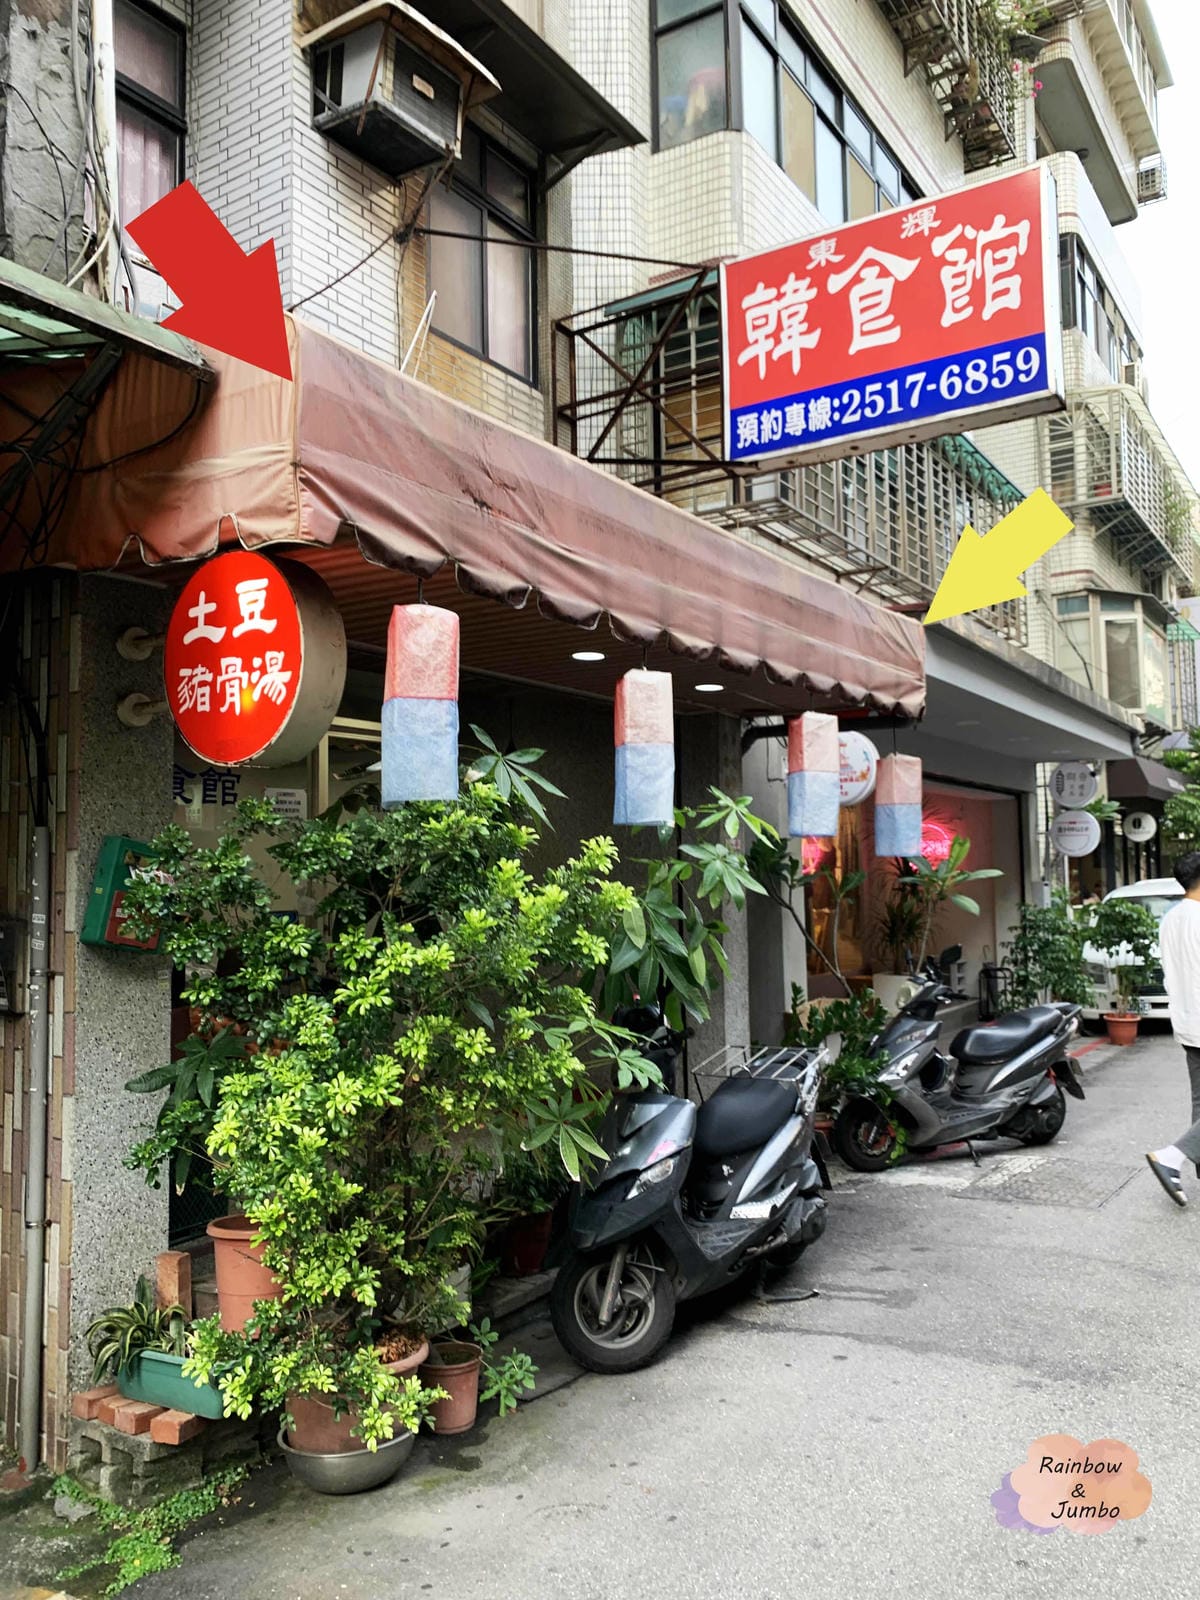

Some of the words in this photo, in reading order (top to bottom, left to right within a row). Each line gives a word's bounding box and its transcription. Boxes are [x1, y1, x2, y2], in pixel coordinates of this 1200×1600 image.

[806, 205, 941, 269] 東輝
[738, 214, 1030, 379] 韓食館
[183, 578, 277, 644] 土豆
[178, 650, 292, 716] 豬骨湯
